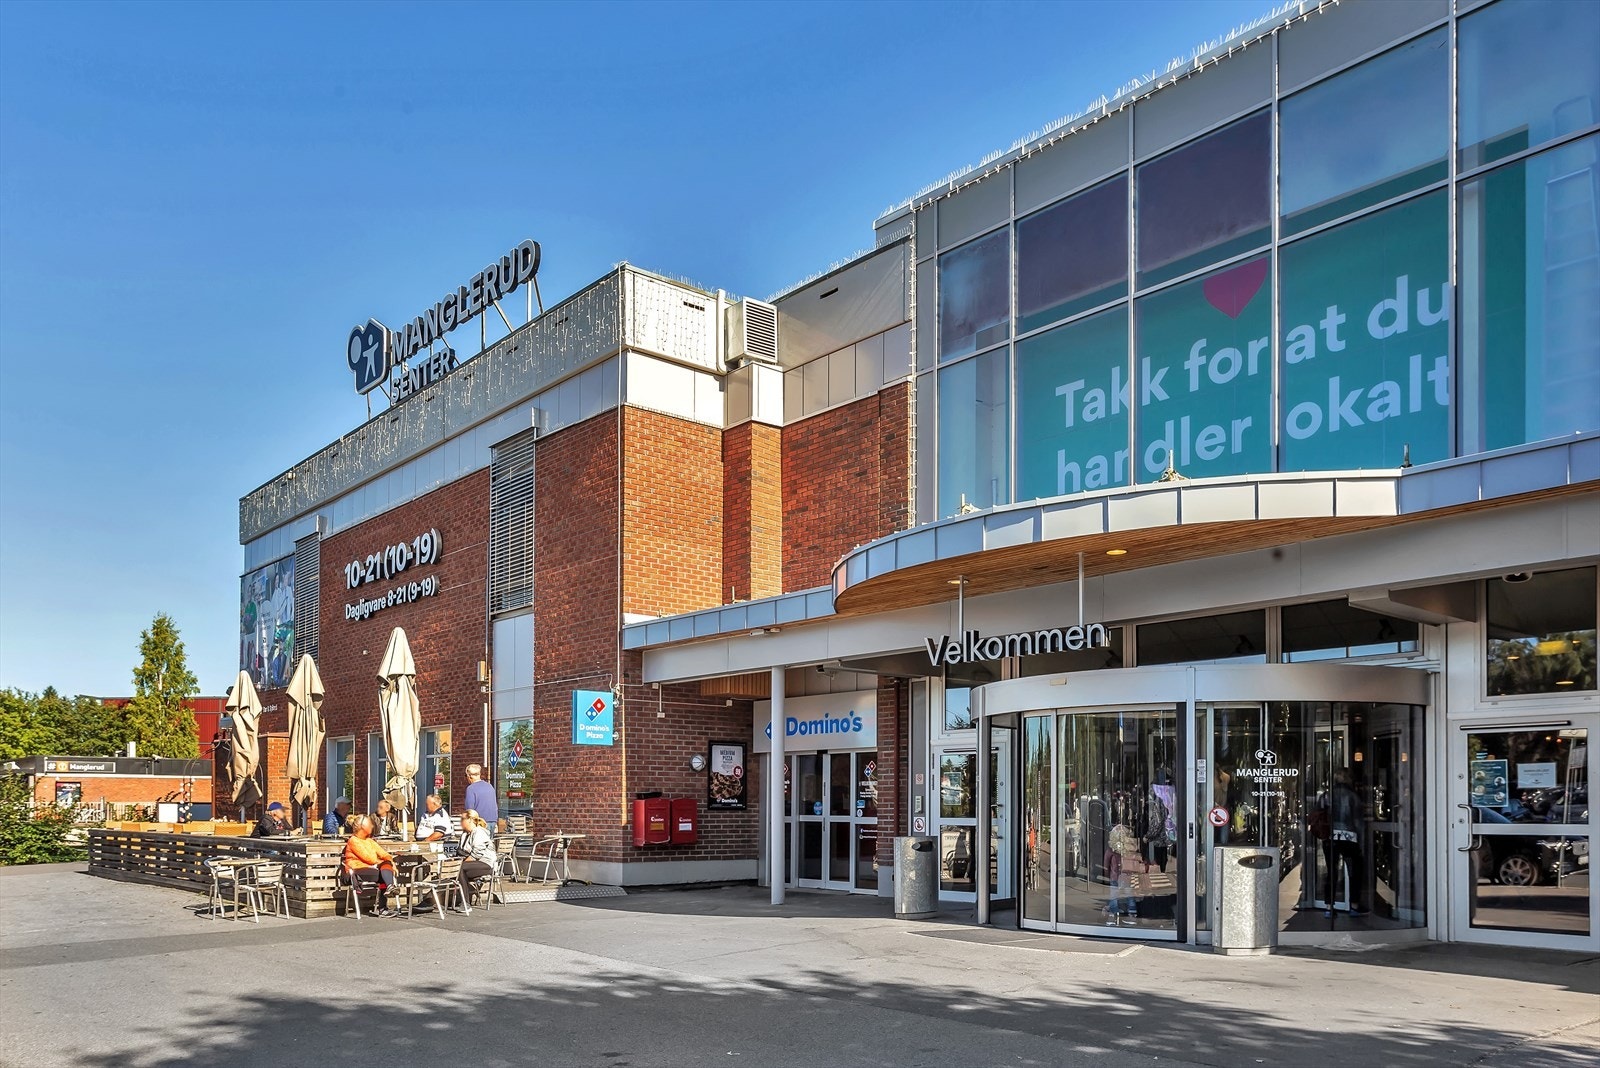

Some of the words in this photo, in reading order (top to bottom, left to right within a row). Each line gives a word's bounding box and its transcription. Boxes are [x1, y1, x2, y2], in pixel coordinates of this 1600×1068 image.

[391, 238, 541, 366] MANGLERUD
[1055, 356, 1170, 428] Takk
[1184, 337, 1268, 392] for
[1285, 304, 1347, 364] at
[1366, 274, 1450, 340] du
[391, 347, 455, 406] SENTER
[1057, 414, 1253, 496] handler
[1270, 354, 1451, 446] okalt
[344, 551, 381, 590] 10-21
[383, 528, 439, 580] (10-19)
[345, 597, 387, 621] Dagligvare
[387, 585, 407, 607] 8-21
[407, 575, 437, 603] (9-19)
[924, 623, 1106, 667] Velkommen
[579, 723, 610, 732] Domino's
[586, 731, 604, 739] Pizza
[785, 710, 863, 737] Domino's
[69, 763, 105, 772] Manglerud
[505, 771, 526, 780] Domino's
[509, 780, 522, 788] Pizza
[1236, 768, 1299, 777] MANGLERUD
